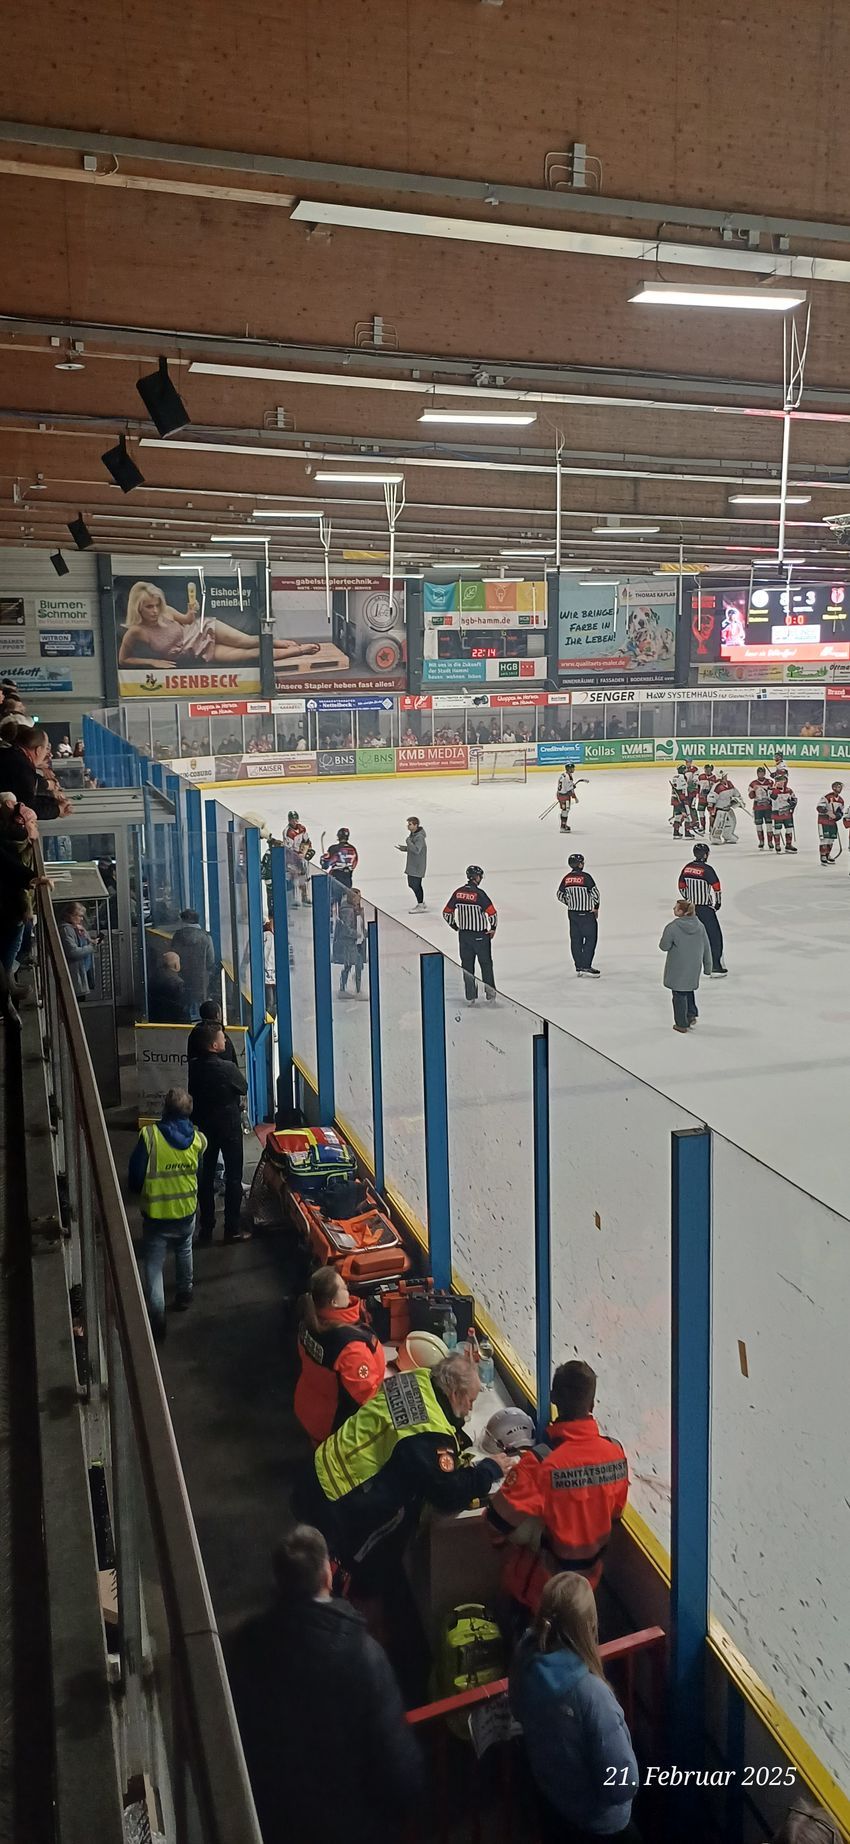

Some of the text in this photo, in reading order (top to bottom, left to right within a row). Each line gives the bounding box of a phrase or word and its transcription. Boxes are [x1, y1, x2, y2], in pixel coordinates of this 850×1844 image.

[281, 578, 380, 586] www.gabelstplertechnik.de
[40, 600, 86, 609] Blumen-
[38, 609, 88, 619] Schmohr
[569, 623, 598, 632] FARBE
[585, 633, 616, 644] LEBEN!
[472, 648, 496, 658] 22:14
[500, 663, 518, 671] HGB
[165, 674, 239, 689] ISENBECK
[275, 682, 303, 690] Unsere
[304, 682, 332, 690] Stapler
[333, 681, 357, 689] heben
[375, 680, 395, 688] alles!
[590, 692, 635, 702] SENGER
[667, 690, 718, 699] SYSTEMHAUS
[399, 749, 425, 761] KMB
[427, 747, 465, 760] MEDIA
[585, 745, 615, 757] Kollas
[622, 743, 643, 755] LVM
[681, 744, 706, 755] WIR
[710, 743, 746, 755] HALTEN
[758, 743, 796, 756] HAMM
[800, 744, 820, 756] AM
[335, 755, 354, 765] BNS
[374, 753, 393, 763] BNS
[258, 764, 282, 772] KAISER
